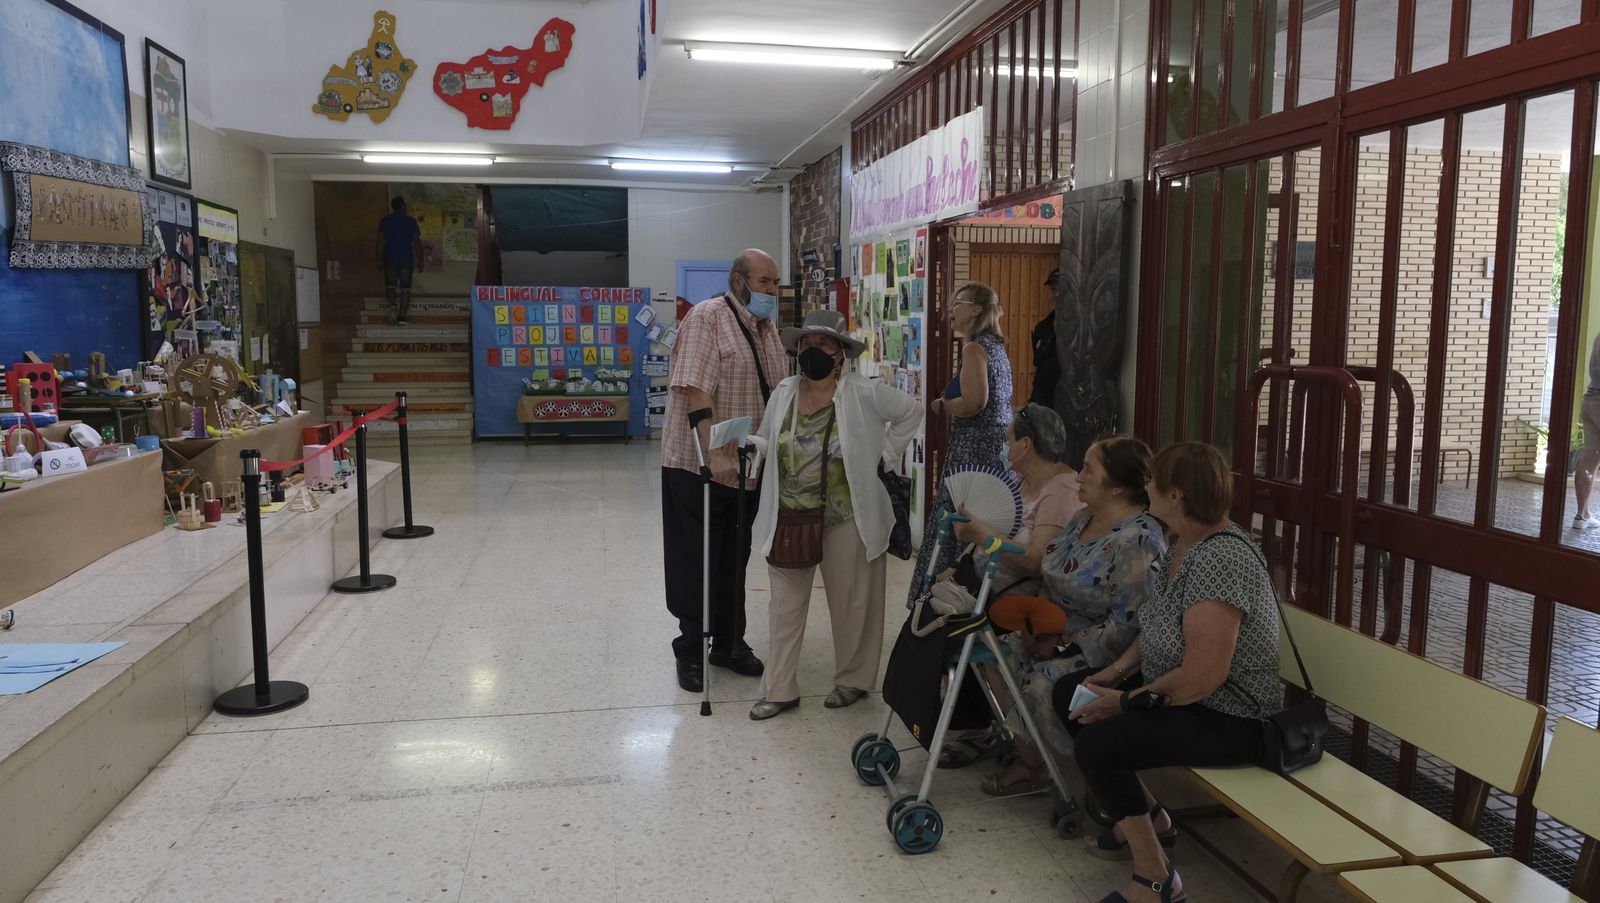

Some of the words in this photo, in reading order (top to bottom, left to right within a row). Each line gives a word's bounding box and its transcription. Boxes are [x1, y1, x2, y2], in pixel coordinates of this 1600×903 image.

[476, 286, 563, 302] BILINGUAL
[579, 287, 645, 303] CORNER
[496, 306, 628, 322] SCIENCES
[498, 326, 627, 343] PROJECTS
[488, 348, 631, 363] FESTIVALS
